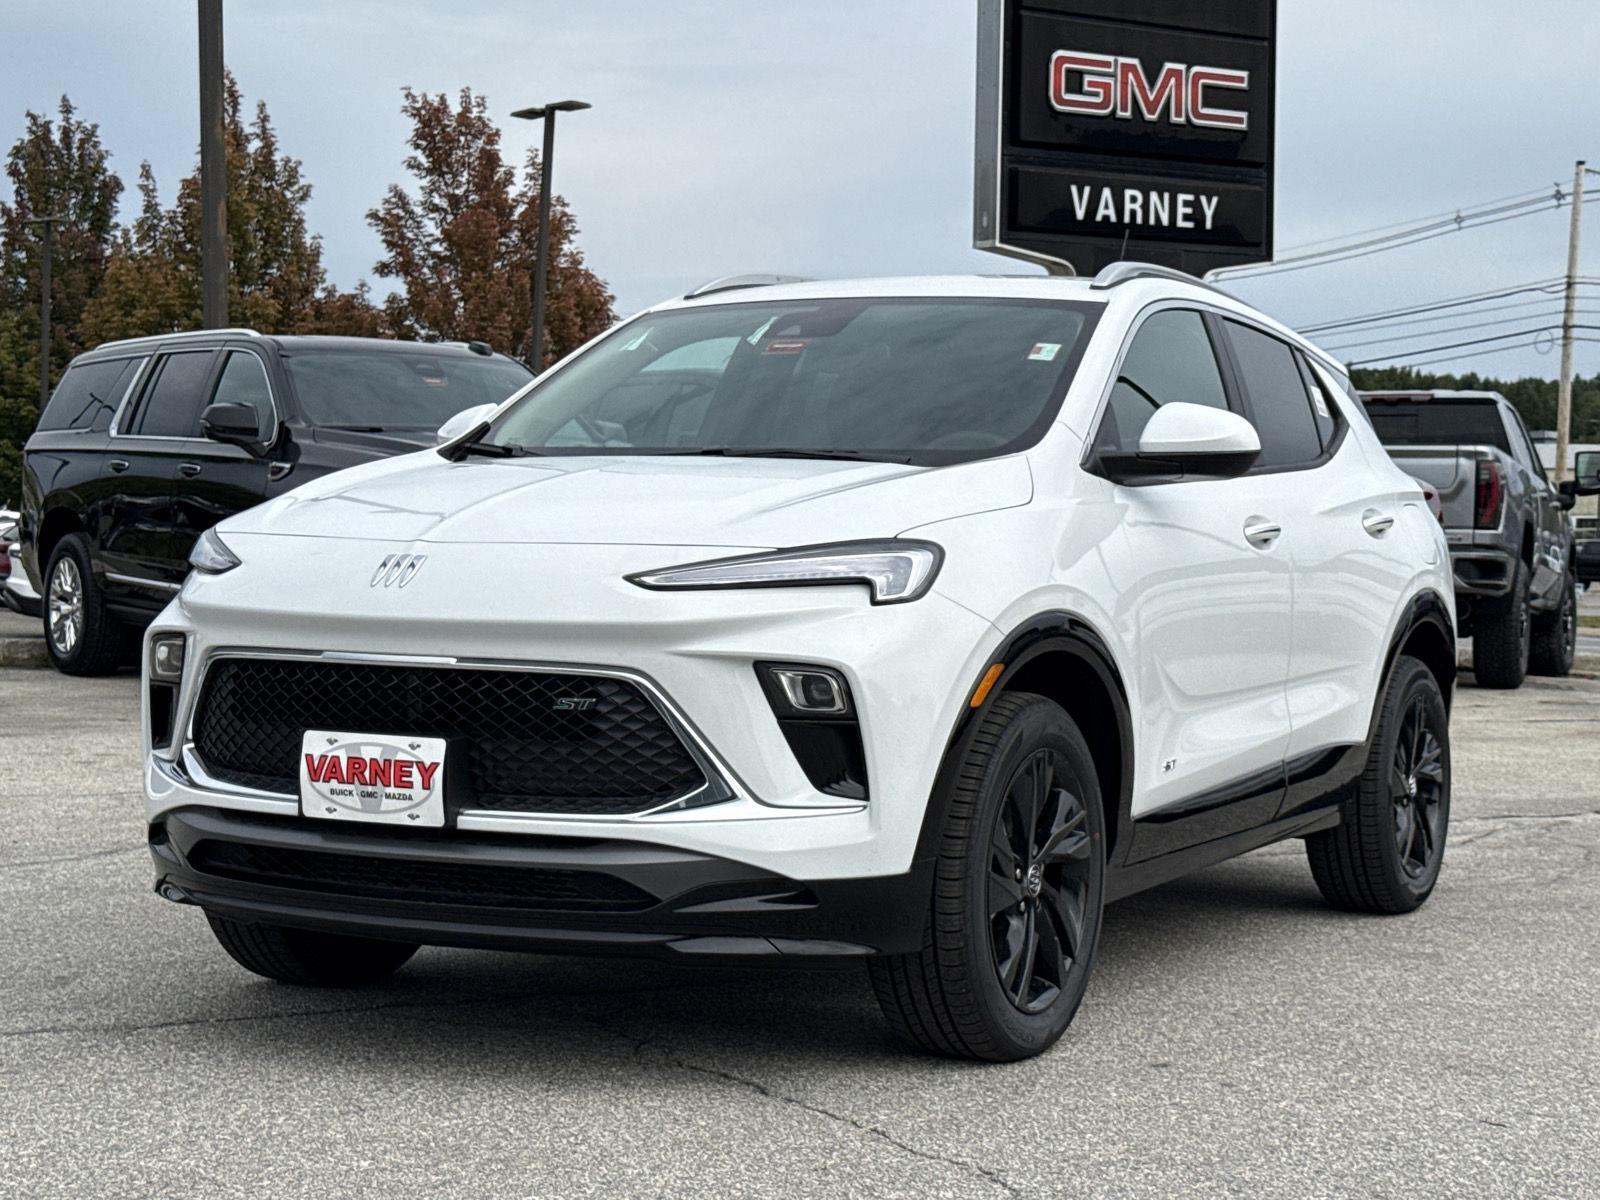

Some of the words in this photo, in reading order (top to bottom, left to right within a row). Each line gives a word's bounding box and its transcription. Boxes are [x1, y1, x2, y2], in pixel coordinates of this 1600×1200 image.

[1050, 49, 1249, 130] GMC
[1070, 184, 1218, 229] VARNEY
[553, 697, 596, 710] ST
[305, 753, 441, 790] VARNEY
[330, 788, 354, 797] BUICK
[361, 790, 378, 799] GMC
[385, 792, 413, 801] MAZDA
